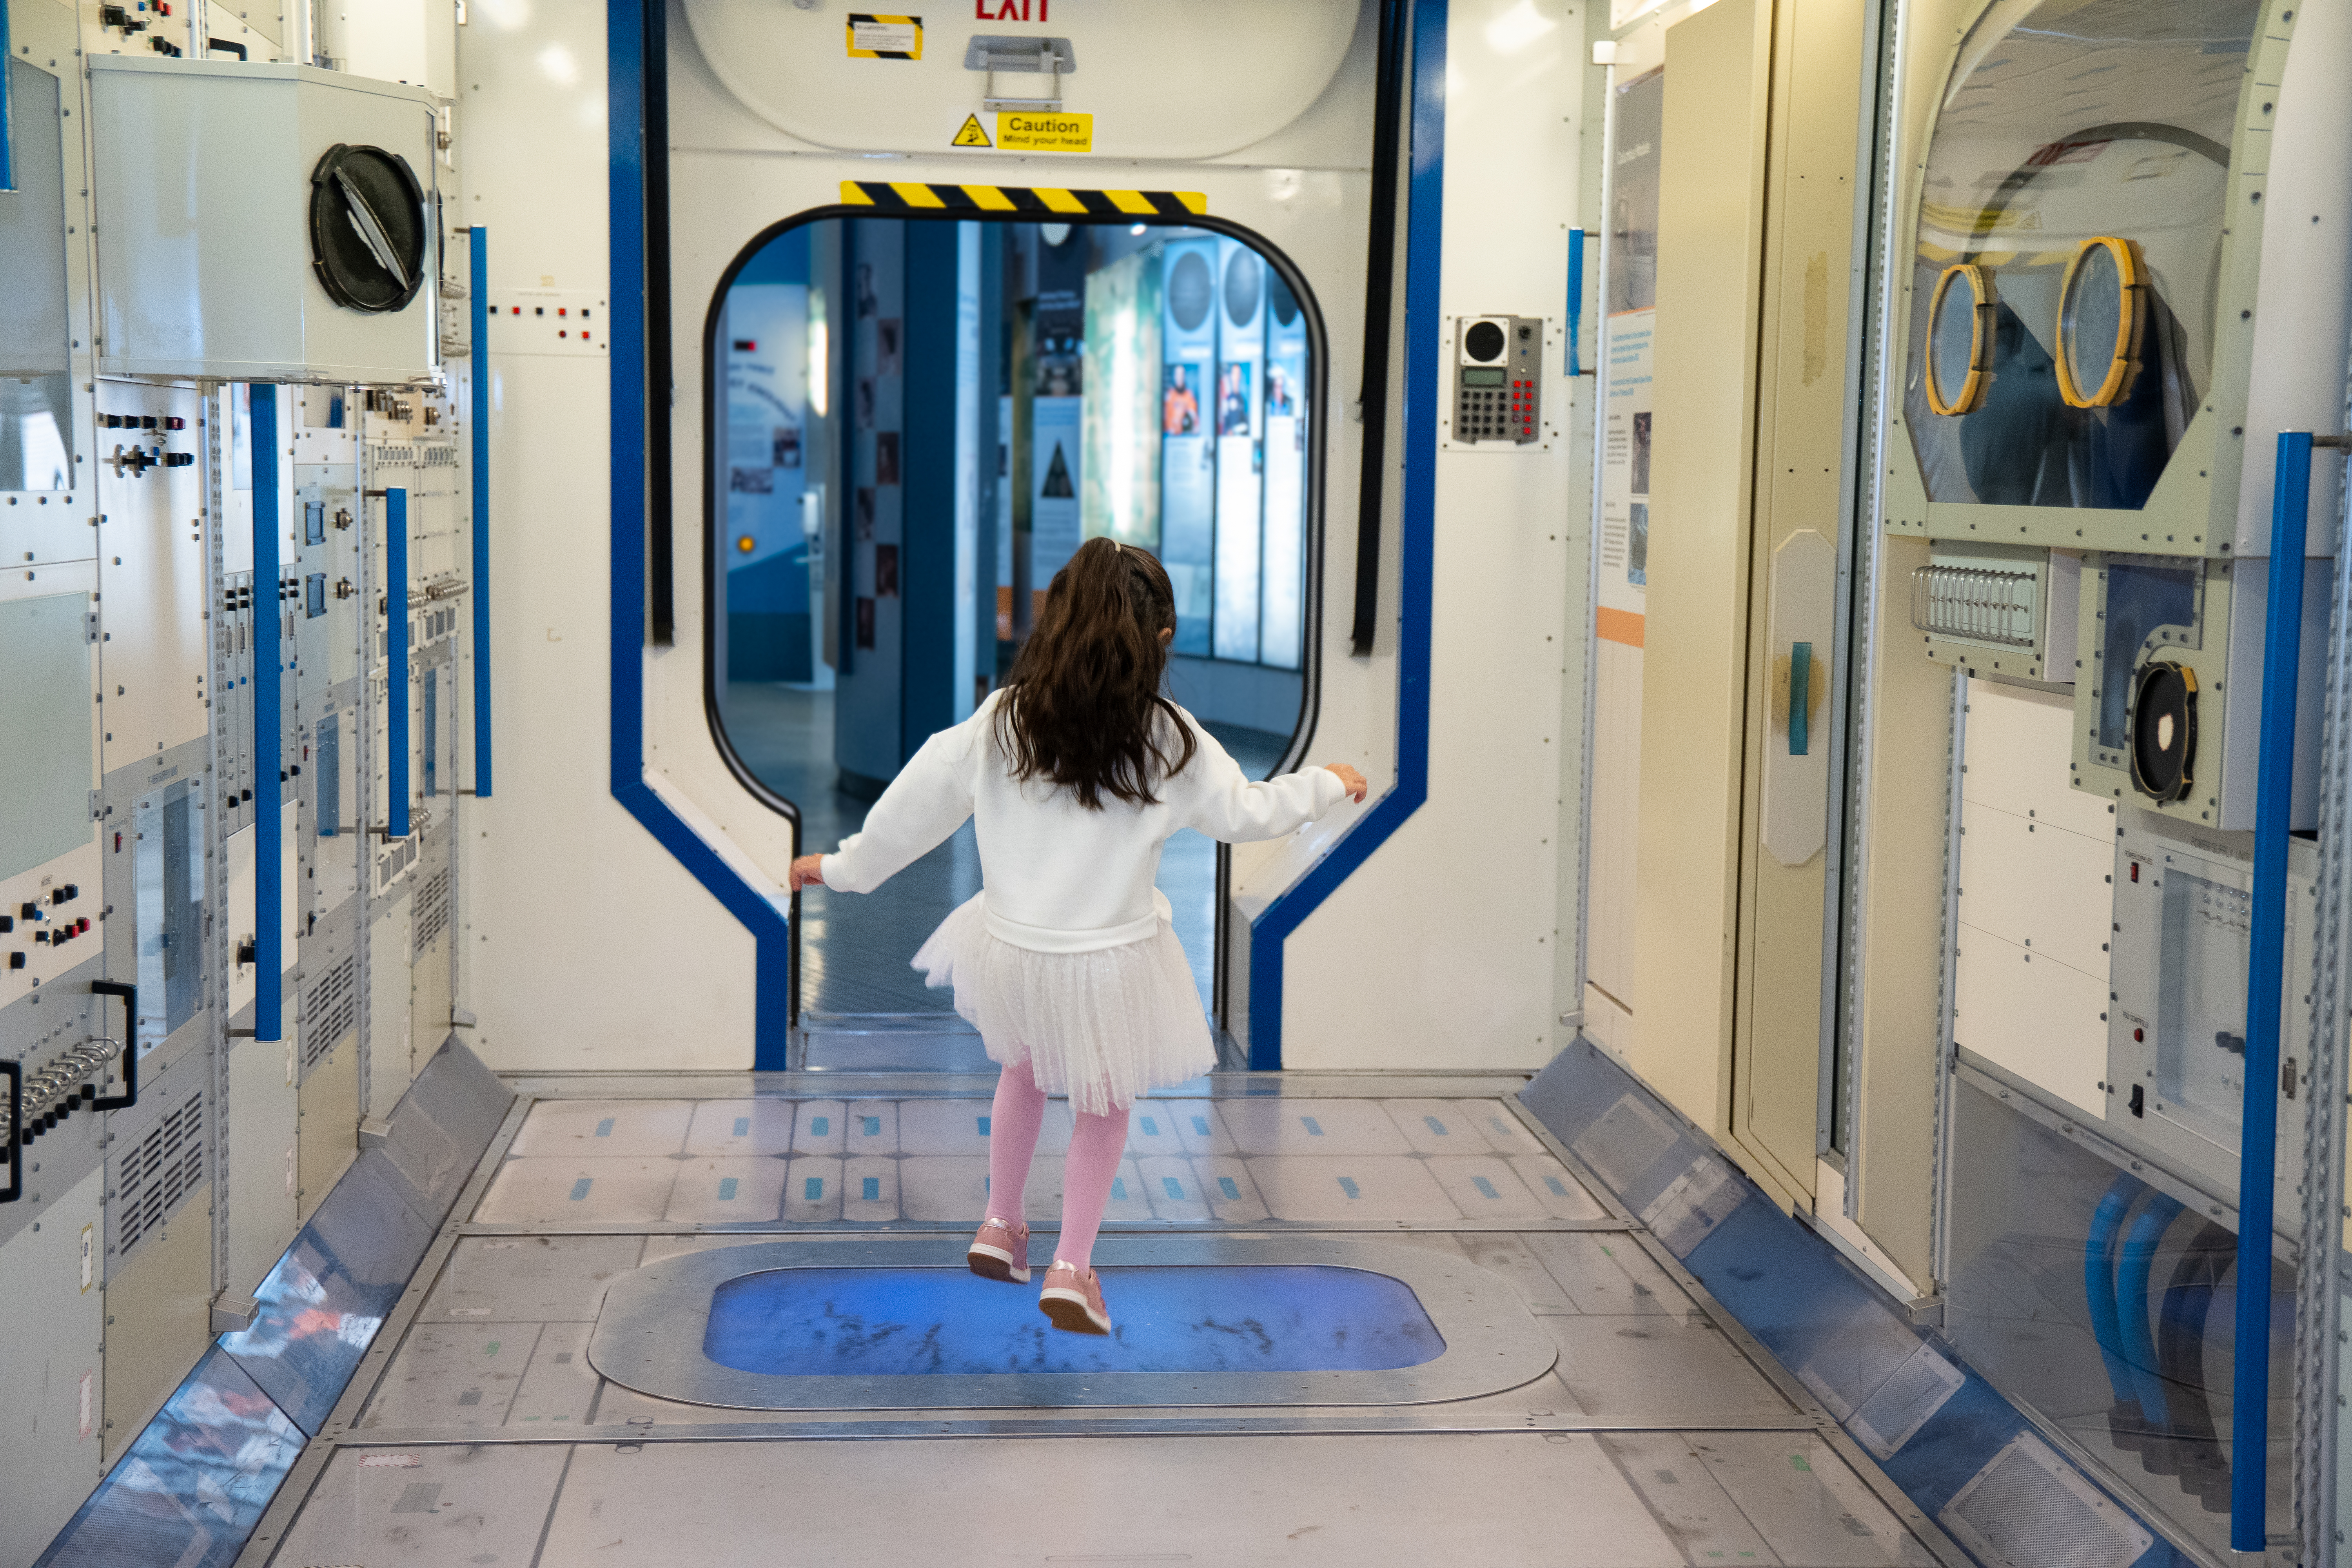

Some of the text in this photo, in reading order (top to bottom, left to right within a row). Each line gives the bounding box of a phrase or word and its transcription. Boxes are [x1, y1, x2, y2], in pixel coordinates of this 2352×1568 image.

[1009, 117, 1079, 133] Caution
[1004, 134, 1088, 146] Mind your head
